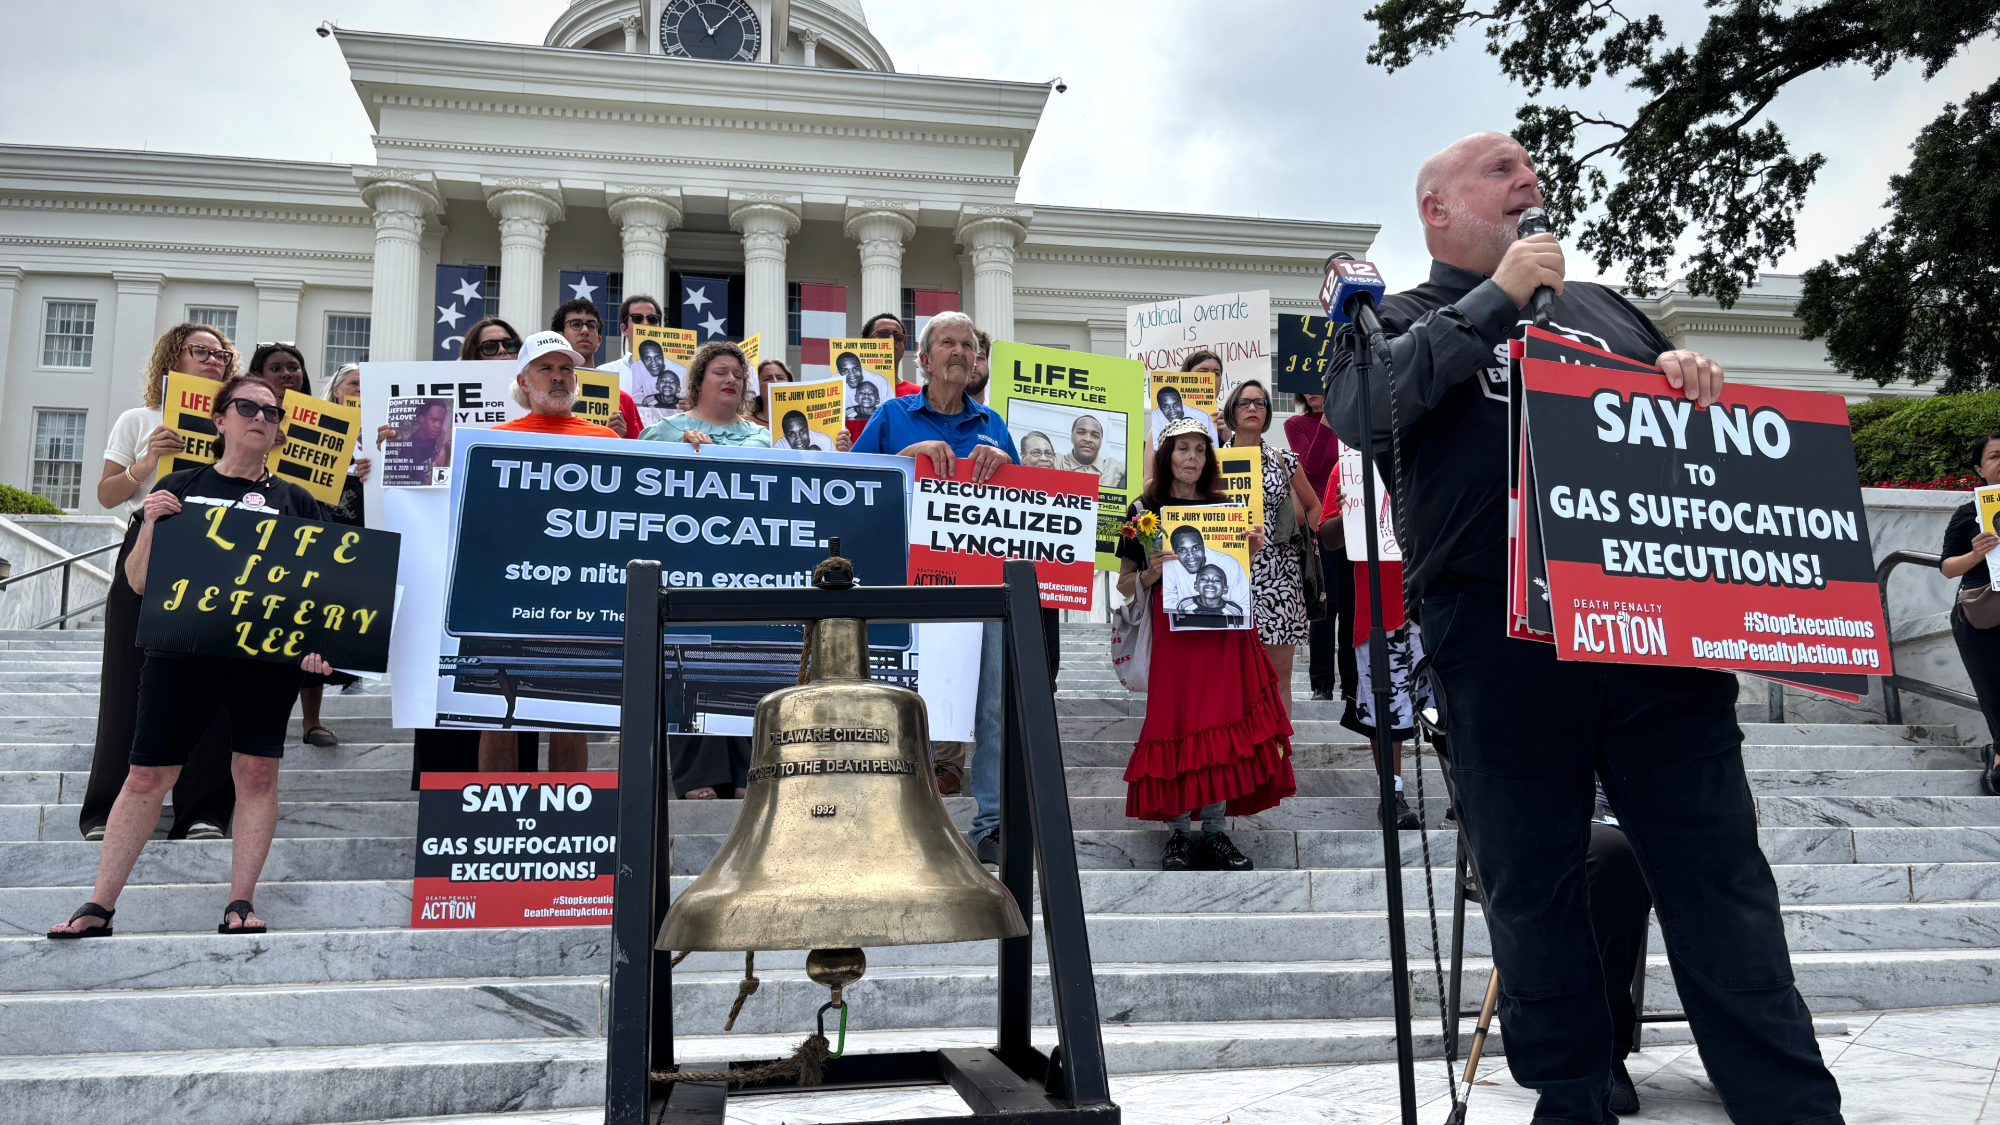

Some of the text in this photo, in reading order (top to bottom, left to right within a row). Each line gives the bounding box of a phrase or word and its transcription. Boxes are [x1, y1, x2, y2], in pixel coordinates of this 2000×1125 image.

[1339, 263, 1377, 276] 12
[1322, 269, 1338, 303] 12
[1345, 276, 1382, 284] WSFA
[1328, 282, 1342, 314] WSFA
[1130, 294, 1248, 347] judicial override
[1300, 315, 1334, 338] LI
[636, 328, 646, 336] THE
[647, 330, 661, 338] JURY
[663, 332, 680, 340] VOTED
[1183, 326, 1197, 341] is
[1128, 340, 1269, 371] NCONSTTIONAL
[1013, 360, 1089, 390] LIFE
[1165, 376, 1179, 384] JURY
[1181, 376, 1198, 384] VOTED
[181, 391, 211, 412] LIFE
[774, 386, 840, 401] THE JURY VOTED LIFE.
[1014, 384, 1106, 404] JEFFERY LEE
[292, 406, 318, 426] LIFE
[589, 402, 609, 416] FOR
[806, 400, 841, 412] ALABAMA PLANS
[814, 410, 832, 419] EXECUTE
[832, 408, 841, 416] HIM
[476, 412, 505, 422] LEE
[1594, 392, 1791, 459] SAY NO
[320, 433, 345, 452] FOR
[282, 442, 338, 469] JEFFERY
[312, 470, 334, 488] LEE
[492, 458, 882, 506] THOU SHALT NOT
[1230, 476, 1251, 490] FOR
[1684, 463, 1716, 486] TO
[920, 478, 1092, 511] EXECUTIONS ARE
[1982, 495, 1995, 504] THE
[927, 500, 1082, 535] LEGALIZED
[1166, 512, 1180, 521] THE
[1182, 512, 1200, 521] JURY
[1203, 512, 1225, 522] VOTED
[1228, 512, 1245, 522] LIFE.
[1550, 486, 1858, 542] GAS SUFFOCATION
[205, 506, 359, 563] LIFE
[543, 508, 829, 548] SUFFOCATE.
[930, 530, 1075, 564] LYNCHING
[234, 554, 319, 588] for
[1602, 538, 1823, 586] EXECUTIONS!
[505, 561, 860, 587] stop nitren executis
[1038, 582, 1087, 593] opExecutions
[164, 578, 377, 634] JEFFERY
[512, 607, 625, 622] Paid for by The
[1573, 599, 1663, 613] DEATH PENALTY
[1573, 612, 1668, 656] ACTION
[1744, 612, 1874, 640] #StopExecutions
[235, 622, 305, 656] LEE
[1692, 637, 1880, 669] DeathPenaltyAction.org
[769, 728, 889, 746] DELAWARE CITIZENS
[780, 763, 794, 776] TO
[797, 761, 821, 774] THE
[826, 760, 869, 773] DEATH
[873, 760, 919, 775] PENALTY
[462, 785, 592, 812] SAY NO
[811, 805, 836, 816] 1992
[516, 818, 536, 830] TO
[422, 837, 468, 855] GAS
[451, 861, 596, 880] EXECUTIONS!
[553, 895, 613, 905] #StopExecutio
[421, 902, 476, 920] ACTION
[524, 908, 613, 917] DeathPenaltyAction.o
